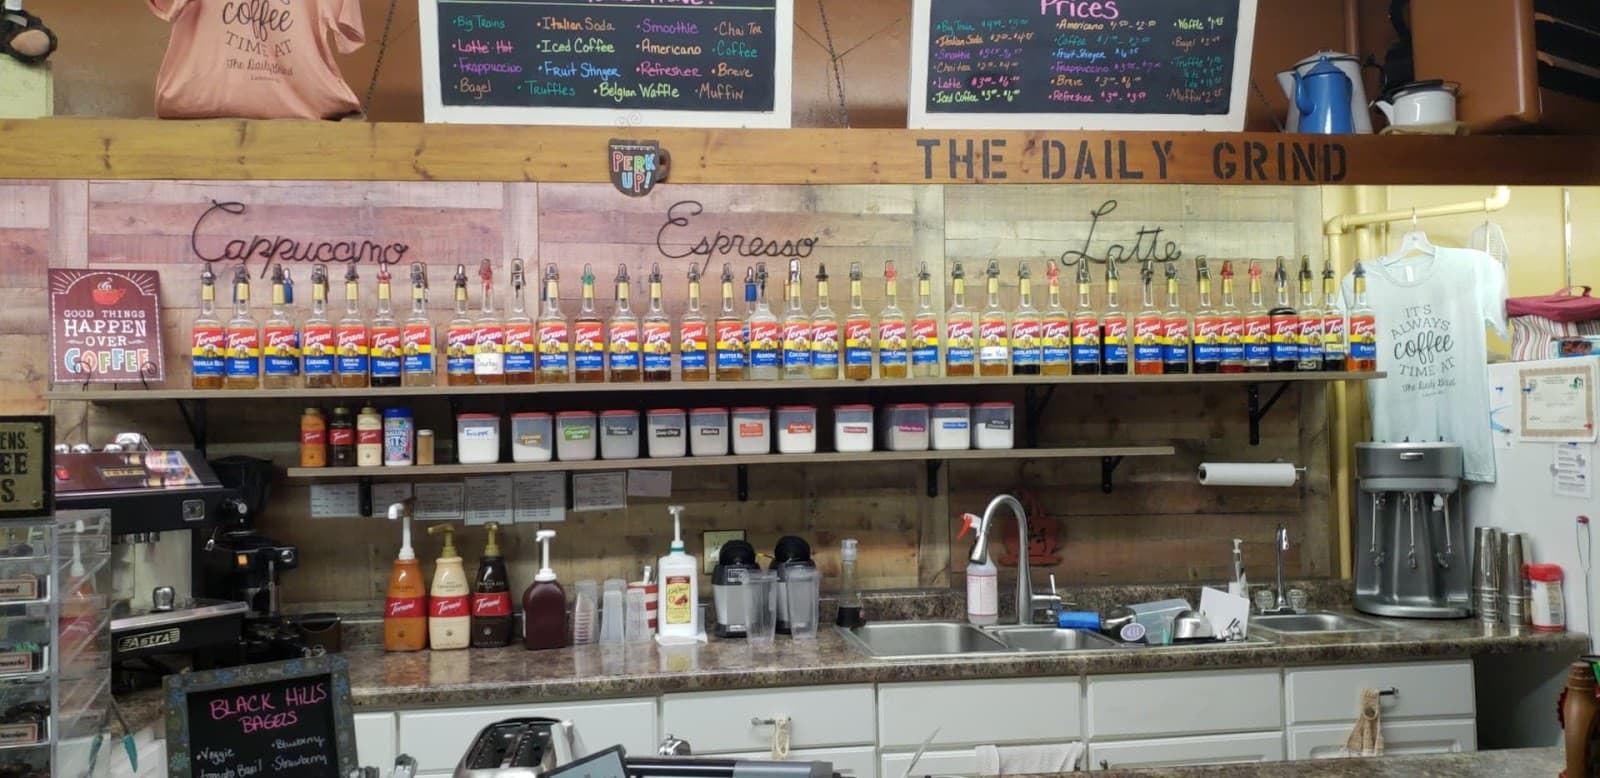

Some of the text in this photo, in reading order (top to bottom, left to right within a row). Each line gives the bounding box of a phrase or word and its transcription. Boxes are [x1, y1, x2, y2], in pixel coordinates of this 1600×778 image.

[1041, 0, 1119, 19] Prices
[223, 0, 293, 41] coffee
[458, 16, 473, 31] Big
[542, 17, 616, 31] Italian Soda
[642, 18, 699, 34] Smoothie
[719, 21, 744, 36] Chai
[1059, 18, 1104, 30] Americano
[226, 31, 292, 58] TIME AT
[496, 40, 514, 54] Hot
[541, 37, 616, 53] Iced Coffee
[641, 38, 702, 55] Americano
[717, 40, 758, 58] Coffee
[459, 57, 522, 74] Frappuccino
[544, 61, 621, 81] Fruit Stinger
[640, 61, 702, 77] Refresher
[717, 62, 754, 78] Breve
[459, 77, 492, 99] Bagel
[525, 80, 576, 96] Truffles
[698, 82, 744, 99] Muffin
[937, 77, 962, 88] Latte
[600, 83, 680, 102] Belgian Waffle
[935, 91, 953, 103] Iced
[613, 151, 656, 173] PERK
[916, 139, 1347, 182] THE DAILY GRIND
[621, 171, 652, 193] UP!
[192, 200, 408, 279] Cappuccino
[657, 200, 819, 275] Espresso
[1062, 200, 1182, 266] Latte
[63, 309, 146, 319] GOOD THINGS
[1405, 304, 1432, 319] IT'S
[64, 319, 147, 337] HAPPEN
[1391, 318, 1451, 340] ALWAYS
[85, 336, 127, 347] OVER
[1394, 330, 1454, 365] coffee
[64, 348, 151, 374] COFFEE
[1400, 356, 1456, 377] TIME AT
[390, 600, 415, 615] Torani
[437, 599, 462, 615] Torani
[476, 596, 501, 613] Torani
[210, 693, 276, 720] BLACK
[200, 747, 236, 766] Veggie
